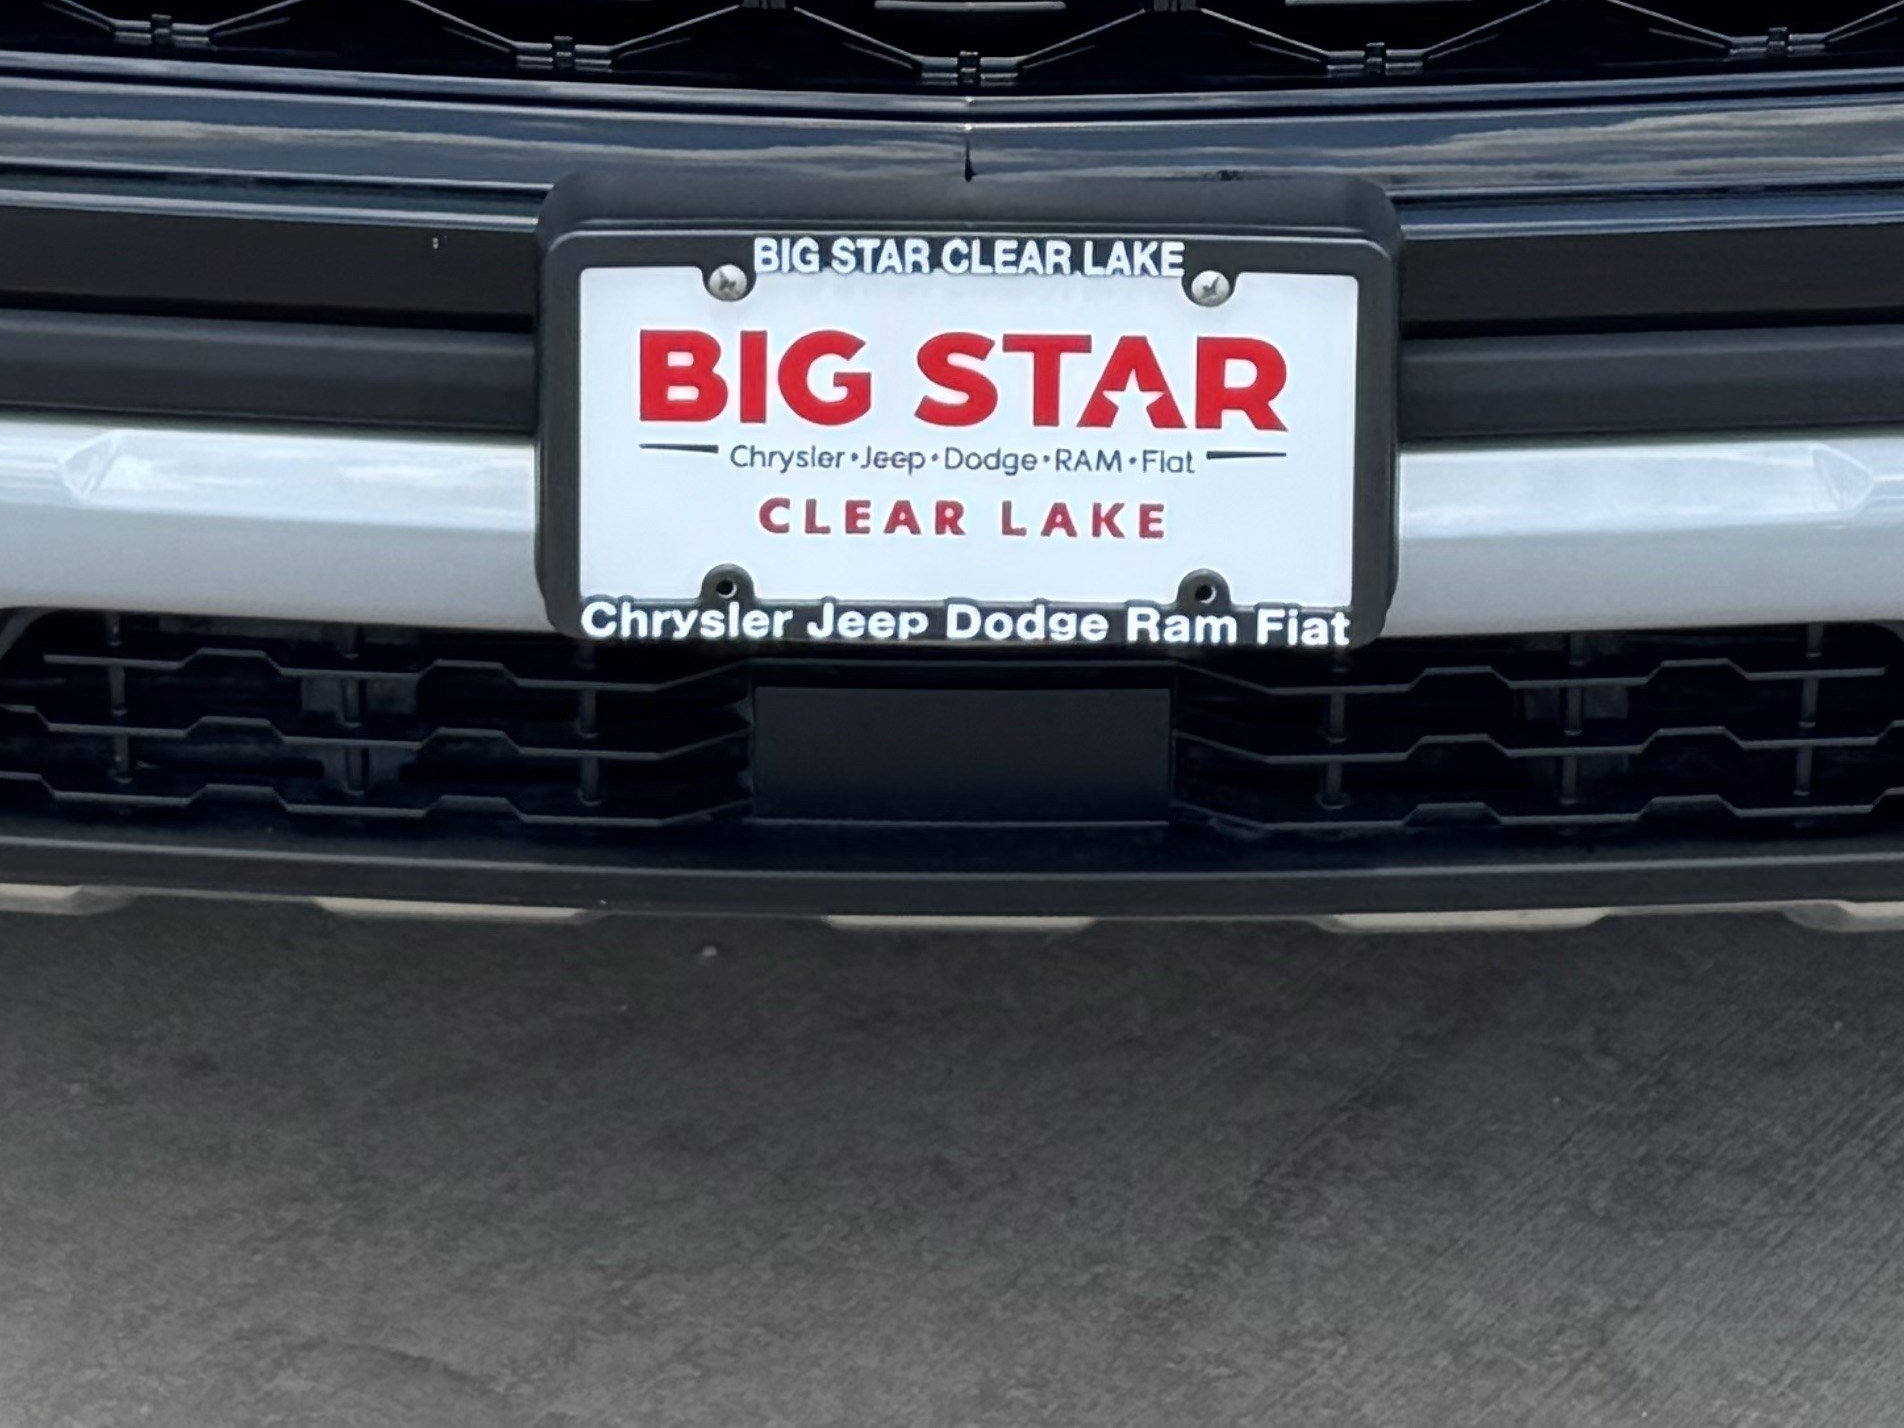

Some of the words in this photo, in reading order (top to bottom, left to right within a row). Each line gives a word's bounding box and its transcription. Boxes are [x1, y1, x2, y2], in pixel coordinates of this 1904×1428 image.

[753, 237, 820, 274] BIG
[831, 237, 930, 275] STAR
[941, 238, 1072, 276] CLEAR
[1083, 240, 1186, 277] LAKE
[640, 329, 871, 426] BIG
[914, 331, 1288, 432] STAR
[730, 444, 845, 473] Chrysler
[860, 445, 927, 476] Jeep
[944, 447, 1038, 476] Dodge
[1055, 448, 1122, 472] RAM
[758, 497, 966, 536] CLEAR
[1001, 500, 1165, 539] LAKE
[581, 601, 793, 640] Chrysler
[807, 601, 929, 640] Jeep
[946, 603, 1109, 642] Dodge
[1127, 605, 1238, 644] Ram
[1256, 607, 1350, 646] Fiat
